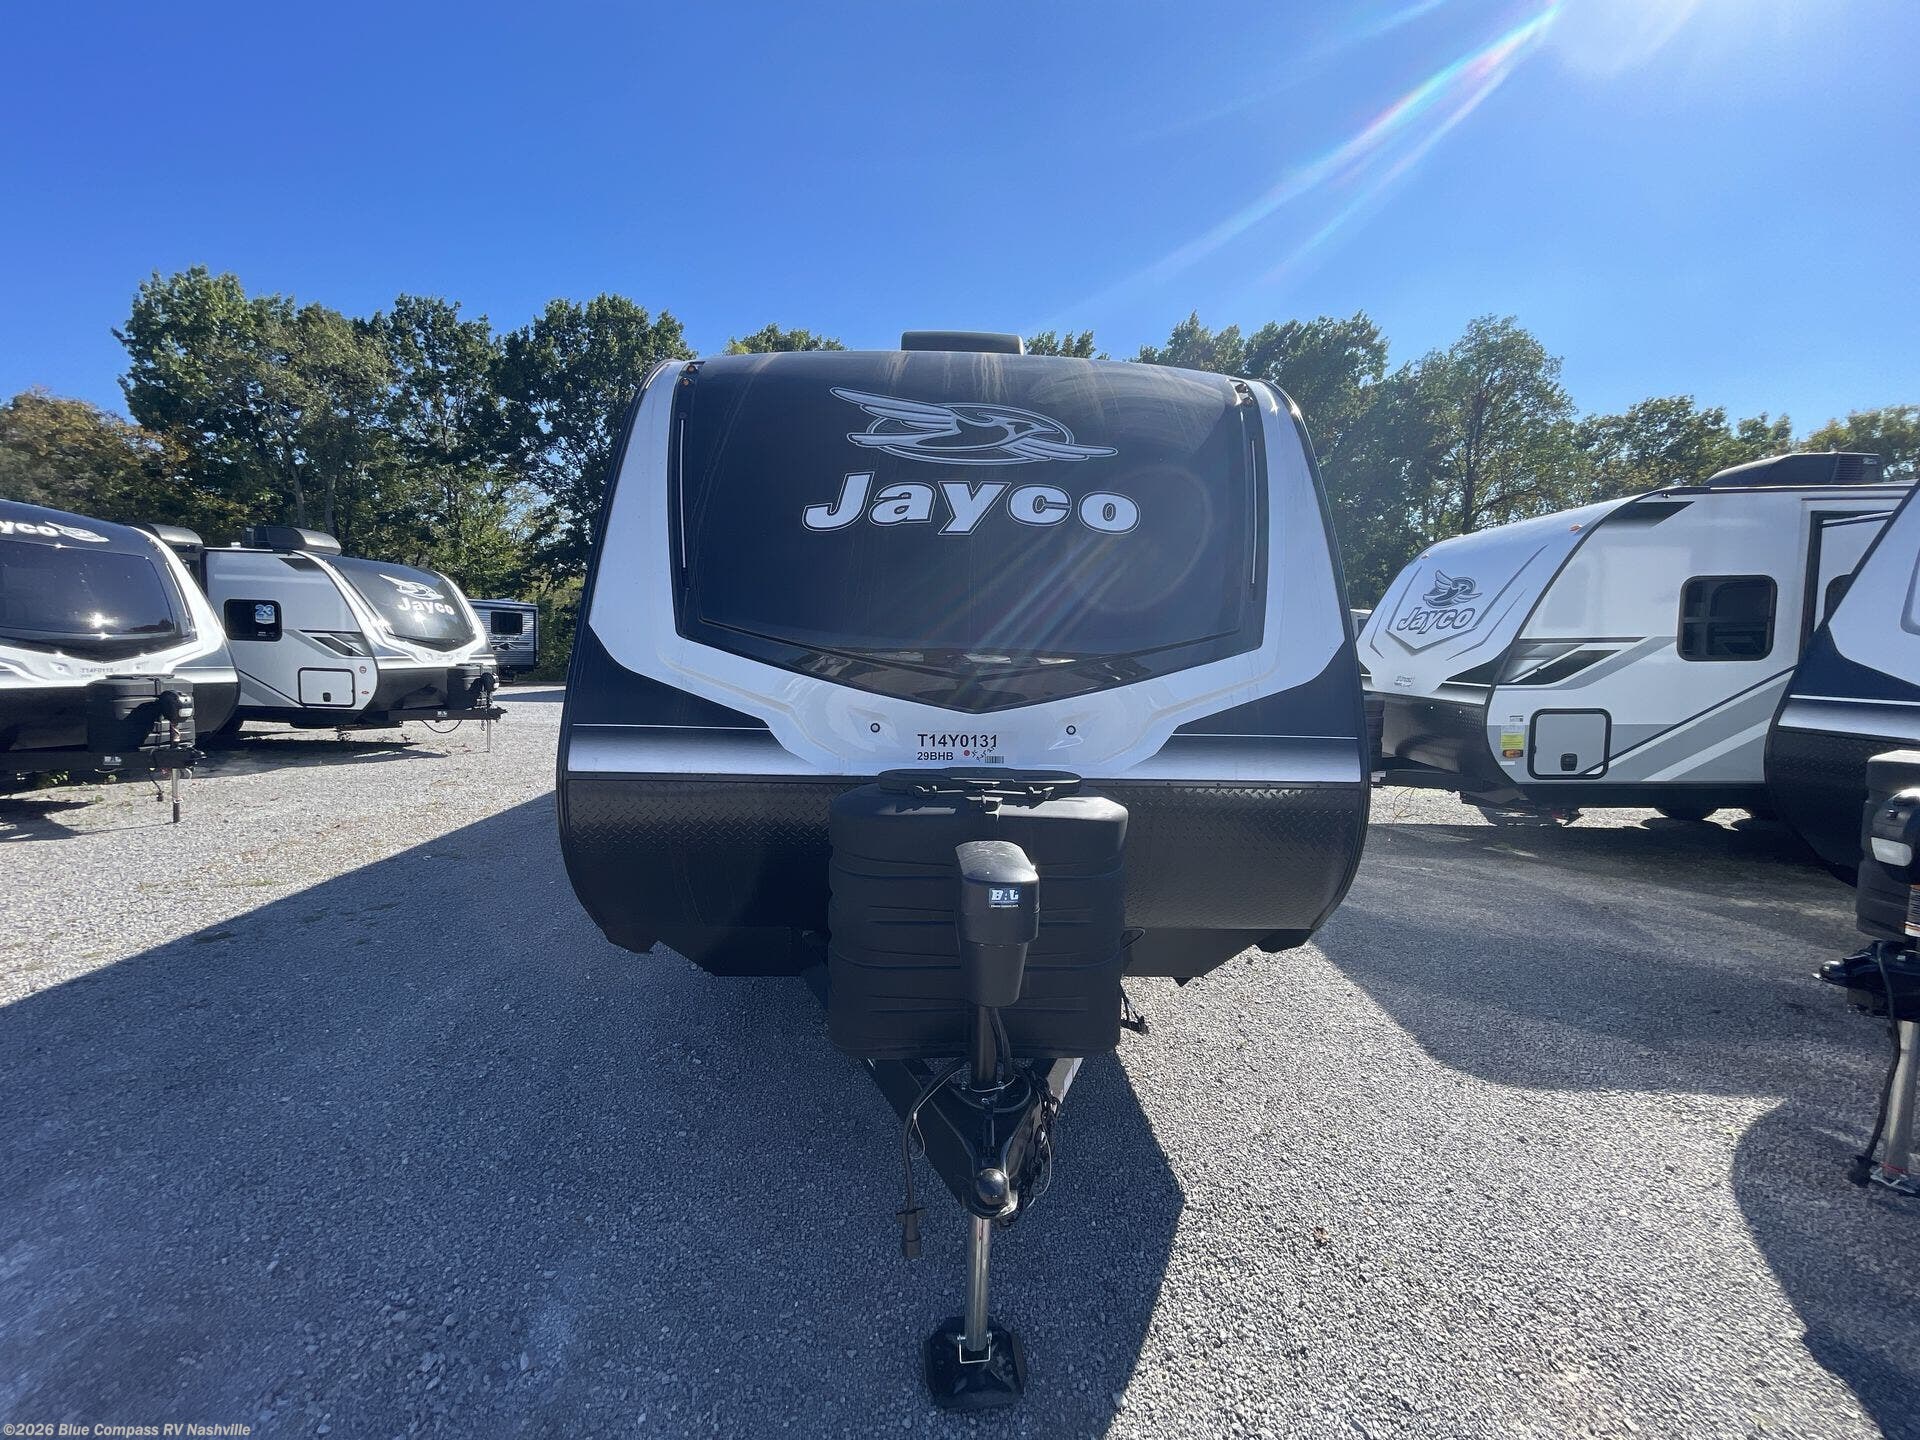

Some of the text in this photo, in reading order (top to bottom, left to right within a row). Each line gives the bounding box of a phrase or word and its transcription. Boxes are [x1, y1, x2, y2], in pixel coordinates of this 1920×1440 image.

[801, 471, 1141, 536] Jayco
[255, 604, 274, 616] 23
[397, 597, 455, 616] Jayco
[1396, 606, 1476, 635] Jayco
[917, 733, 997, 748] T14Y0131
[917, 751, 954, 761] 29BHB
